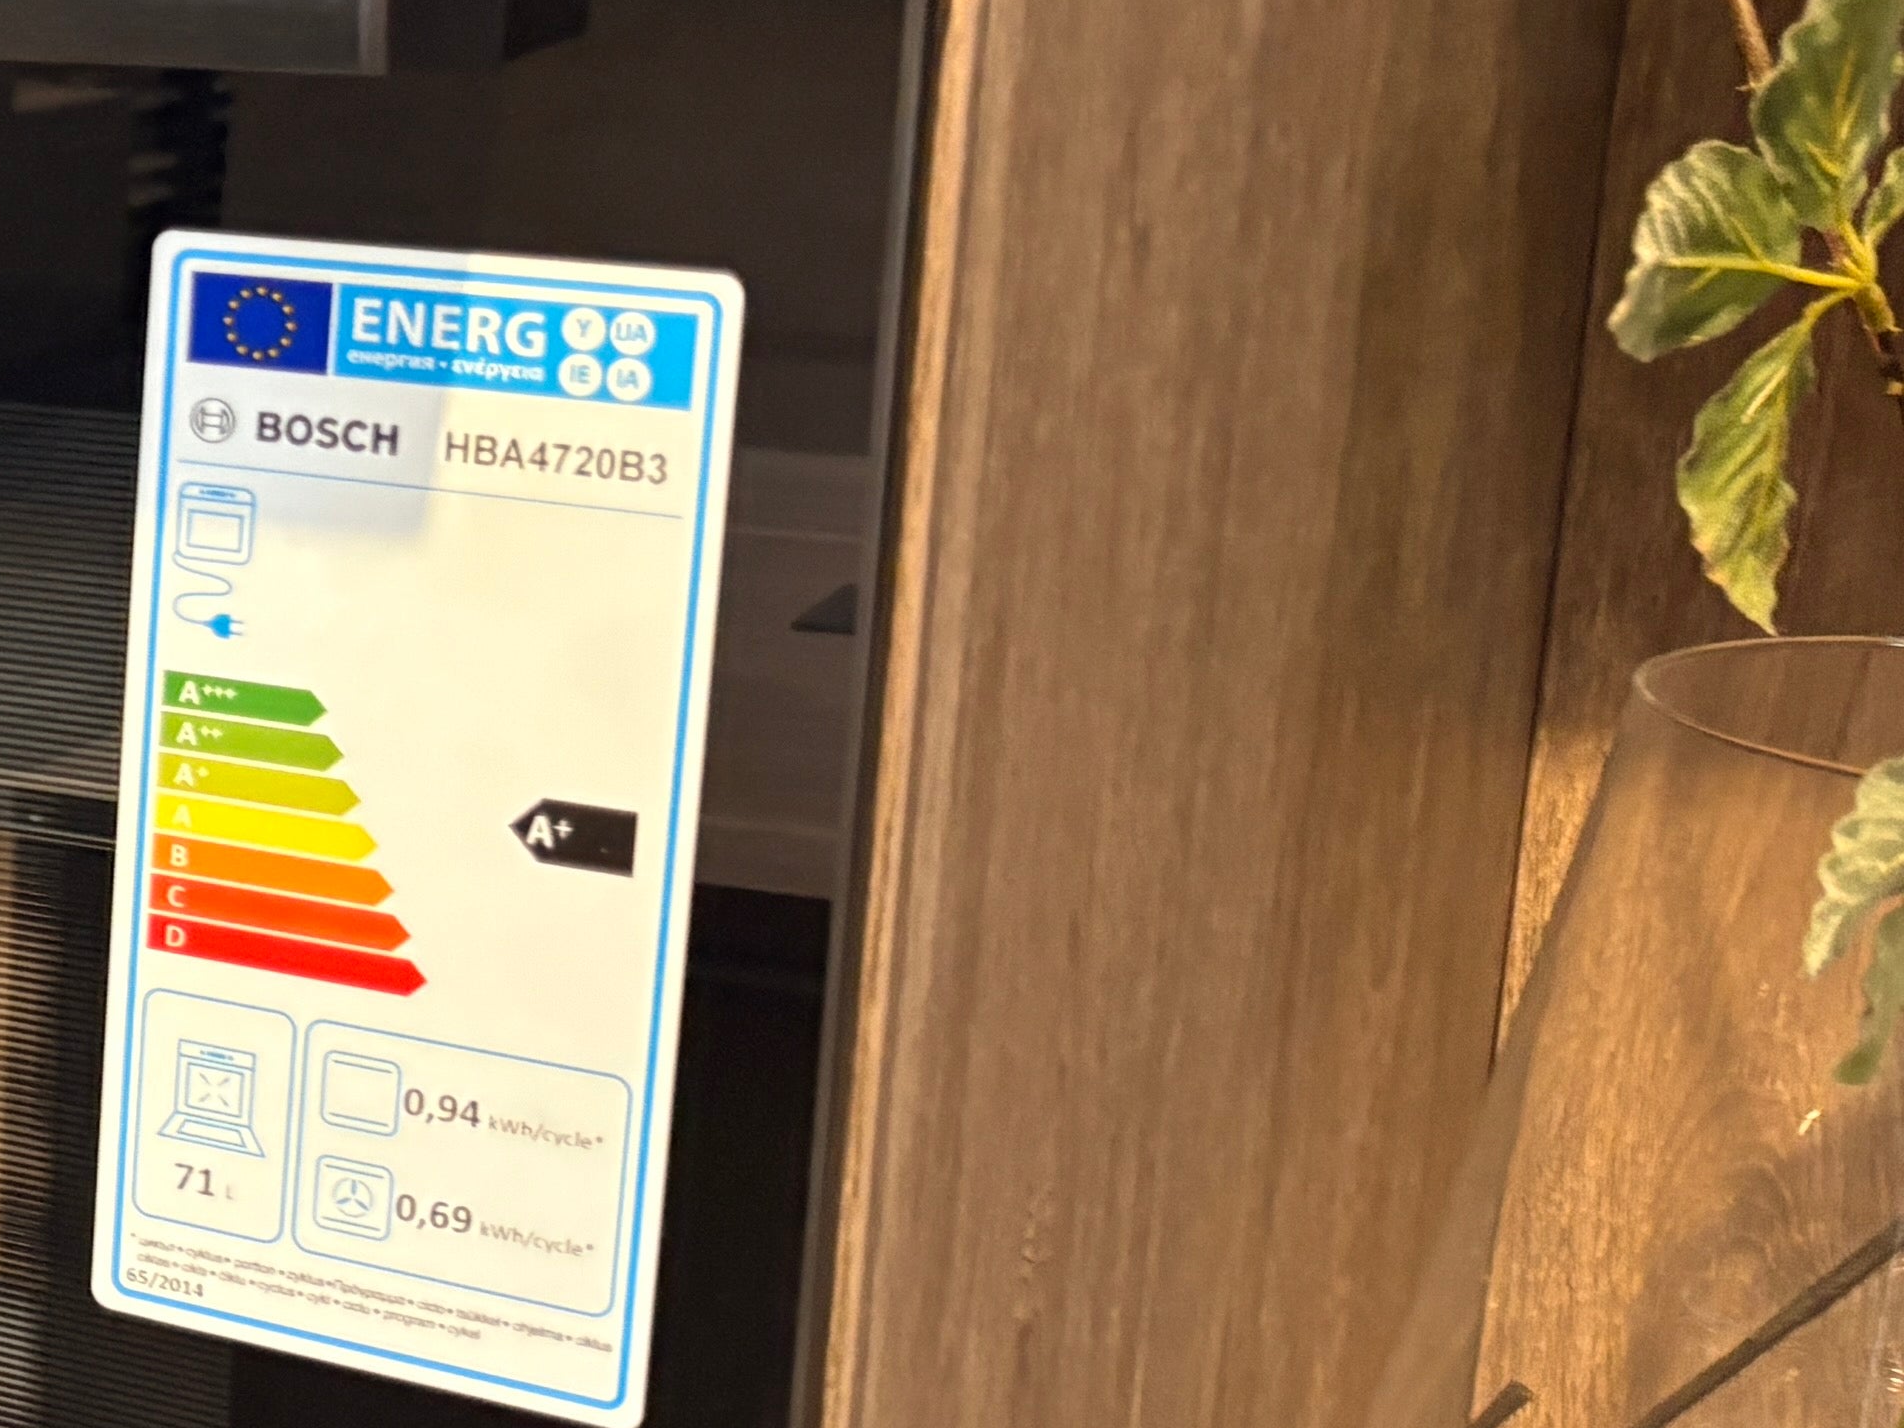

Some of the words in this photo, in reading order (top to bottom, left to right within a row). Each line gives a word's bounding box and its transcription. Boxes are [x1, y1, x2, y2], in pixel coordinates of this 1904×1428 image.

[350, 296, 549, 359] ENERG
[576, 318, 592, 339] Y
[569, 363, 592, 385] IE
[255, 410, 401, 457] BOSCH
[444, 429, 669, 486] HBA4720B3
[178, 678, 237, 707] A+++
[175, 721, 224, 747] A++
[173, 762, 210, 787] A+
[172, 804, 193, 827] A
[525, 813, 575, 850] A+
[169, 844, 188, 867] B
[166, 885, 185, 908] C
[164, 925, 187, 949] D
[403, 1087, 481, 1128] 0,94
[173, 1163, 215, 1197] 71
[395, 1193, 473, 1234] 0,69
[125, 1267, 205, 1299] 65/2014
